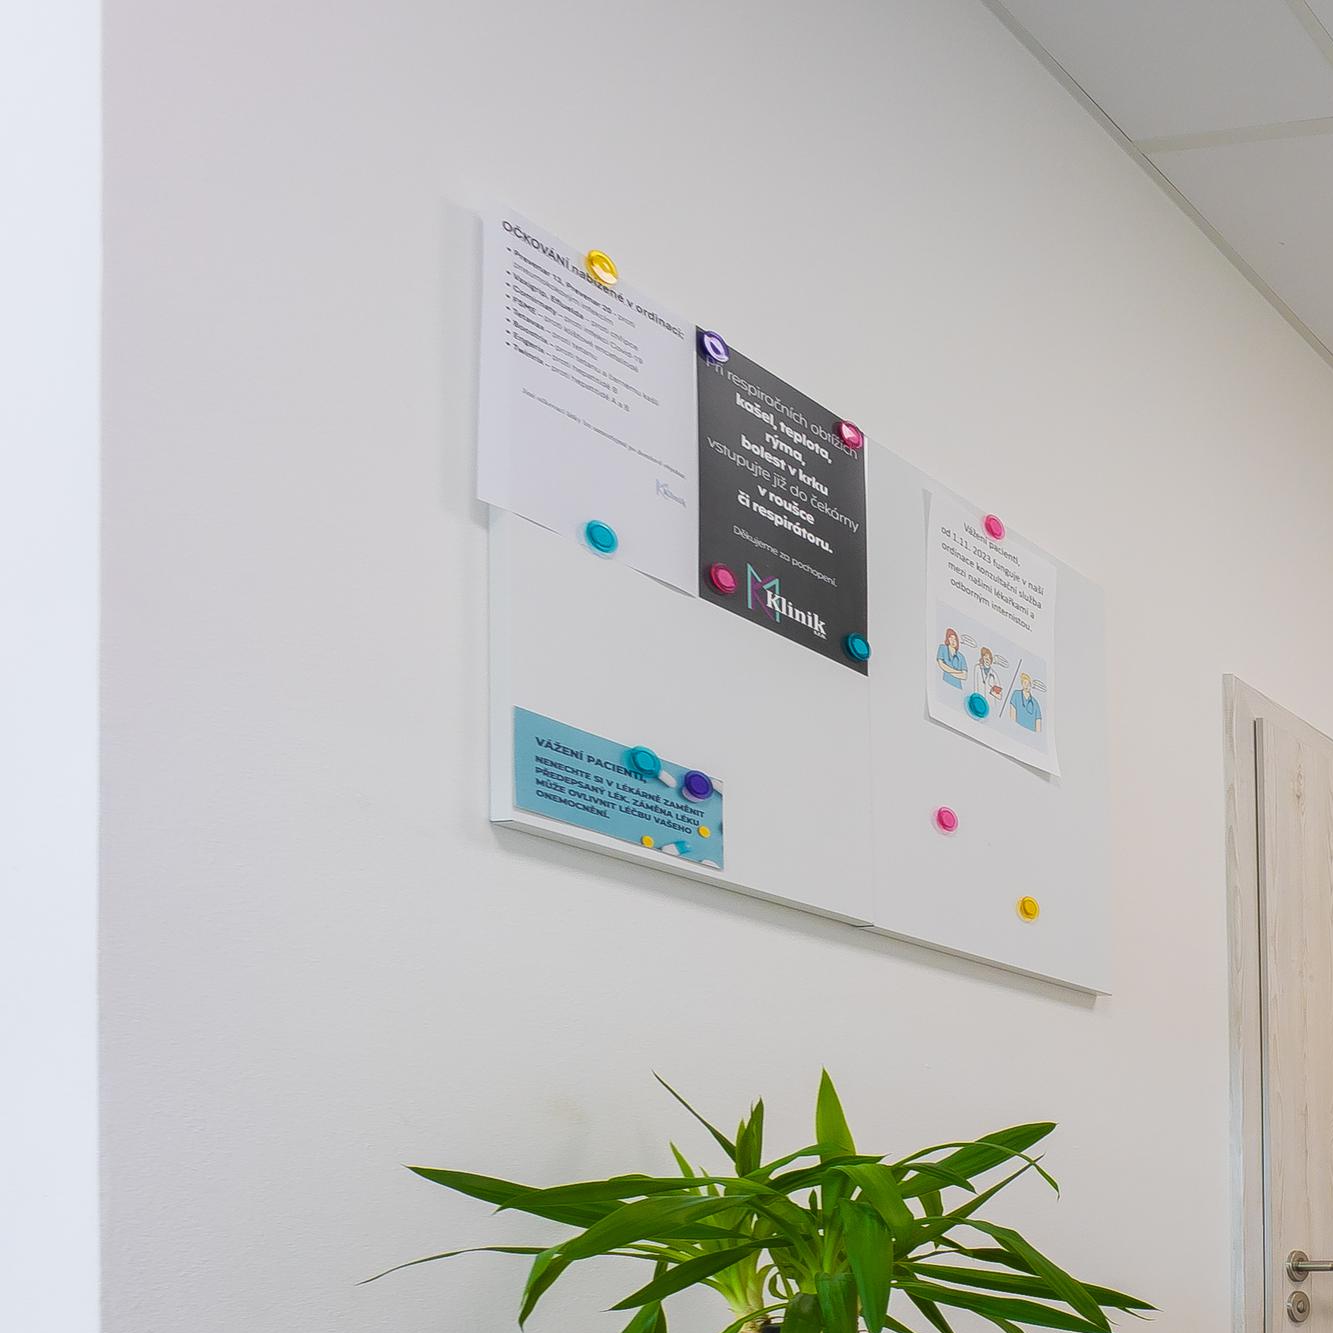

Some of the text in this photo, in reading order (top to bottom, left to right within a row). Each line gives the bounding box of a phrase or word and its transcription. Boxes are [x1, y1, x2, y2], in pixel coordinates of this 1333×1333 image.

[502, 220, 570, 270] OČKOVÁNÍ
[626, 299, 635, 310] v
[727, 371, 808, 428] respiračních
[736, 392, 833, 465] kašel, teplota,
[765, 432, 806, 467] rýma,
[707, 436, 860, 533] vstupujte již do čekárny
[741, 434, 829, 496] bolest v krku
[737, 489, 834, 554] či respirátoru.
[757, 485, 815, 525] v roušce
[733, 525, 779, 556] Děkujeme
[940, 526, 952, 538] od
[972, 546, 992, 565] 2023
[941, 542, 976, 568] ordinace
[947, 561, 967, 577] mezi
[950, 578, 990, 607] odborným
[765, 589, 828, 635] Klinik
[535, 736, 648, 784] VÁŽENÍ PACIENTI,
[535, 755, 705, 818] NENECHTE SI V LÉKÁRNĚ ZAMĚNIT
[535, 765, 606, 796] PŘEDEPSANÝ
[632, 797, 673, 818] ZÁMĚNA
[675, 810, 700, 827] LÉKU
[535, 777, 692, 835] MŮŽE OVLIVNIT LÉČBU VAŠEHO
[536, 790, 610, 819] ONEMOCNĚNÍ.
